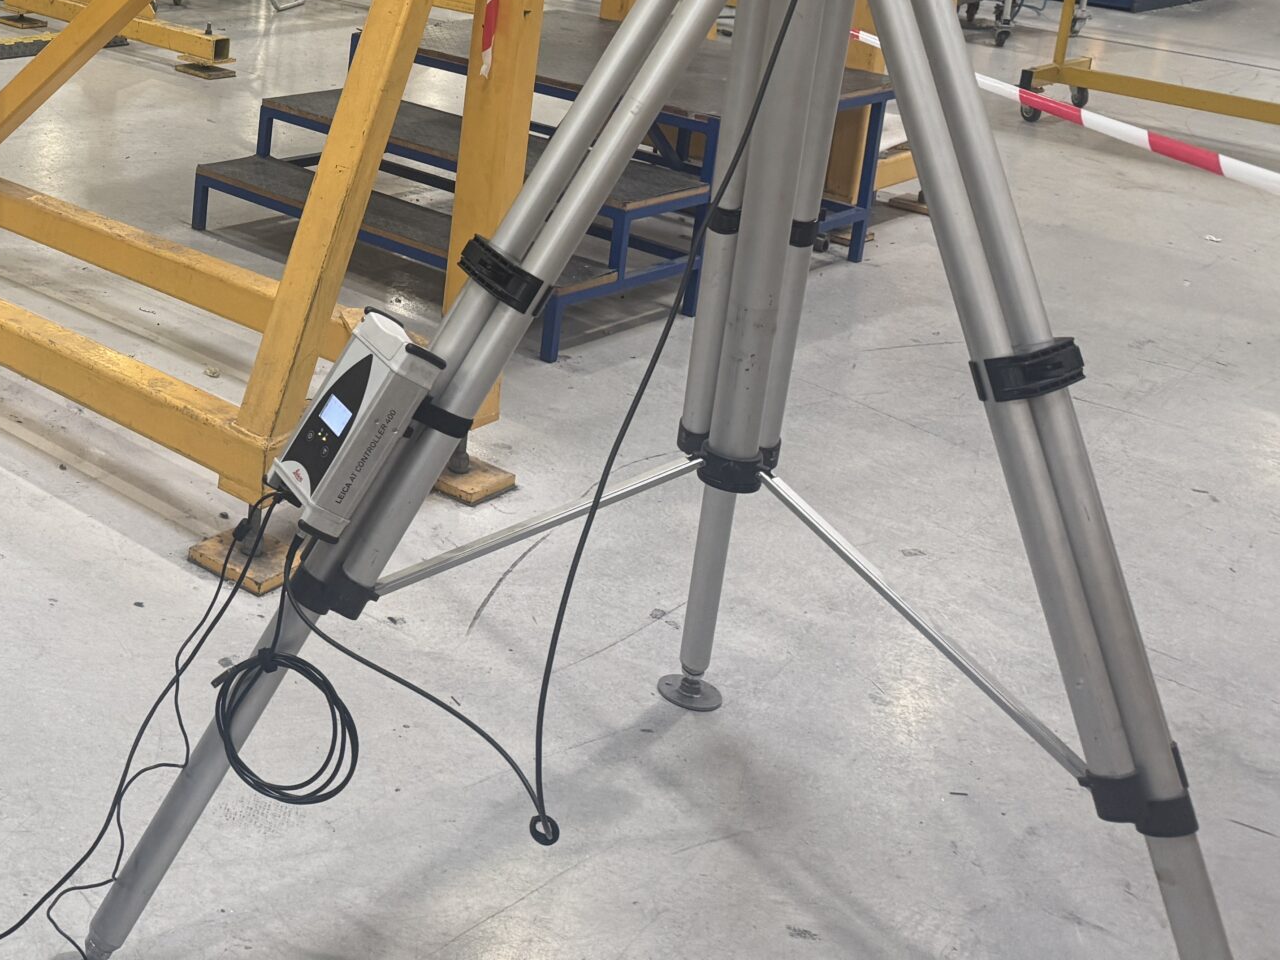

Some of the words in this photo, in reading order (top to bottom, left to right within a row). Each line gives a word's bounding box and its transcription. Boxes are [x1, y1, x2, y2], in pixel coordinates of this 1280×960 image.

[335, 482, 353, 505] LEICA
[349, 472, 358, 483] AT
[355, 423, 388, 473] CONTROLLER
[385, 409, 397, 424] 400
